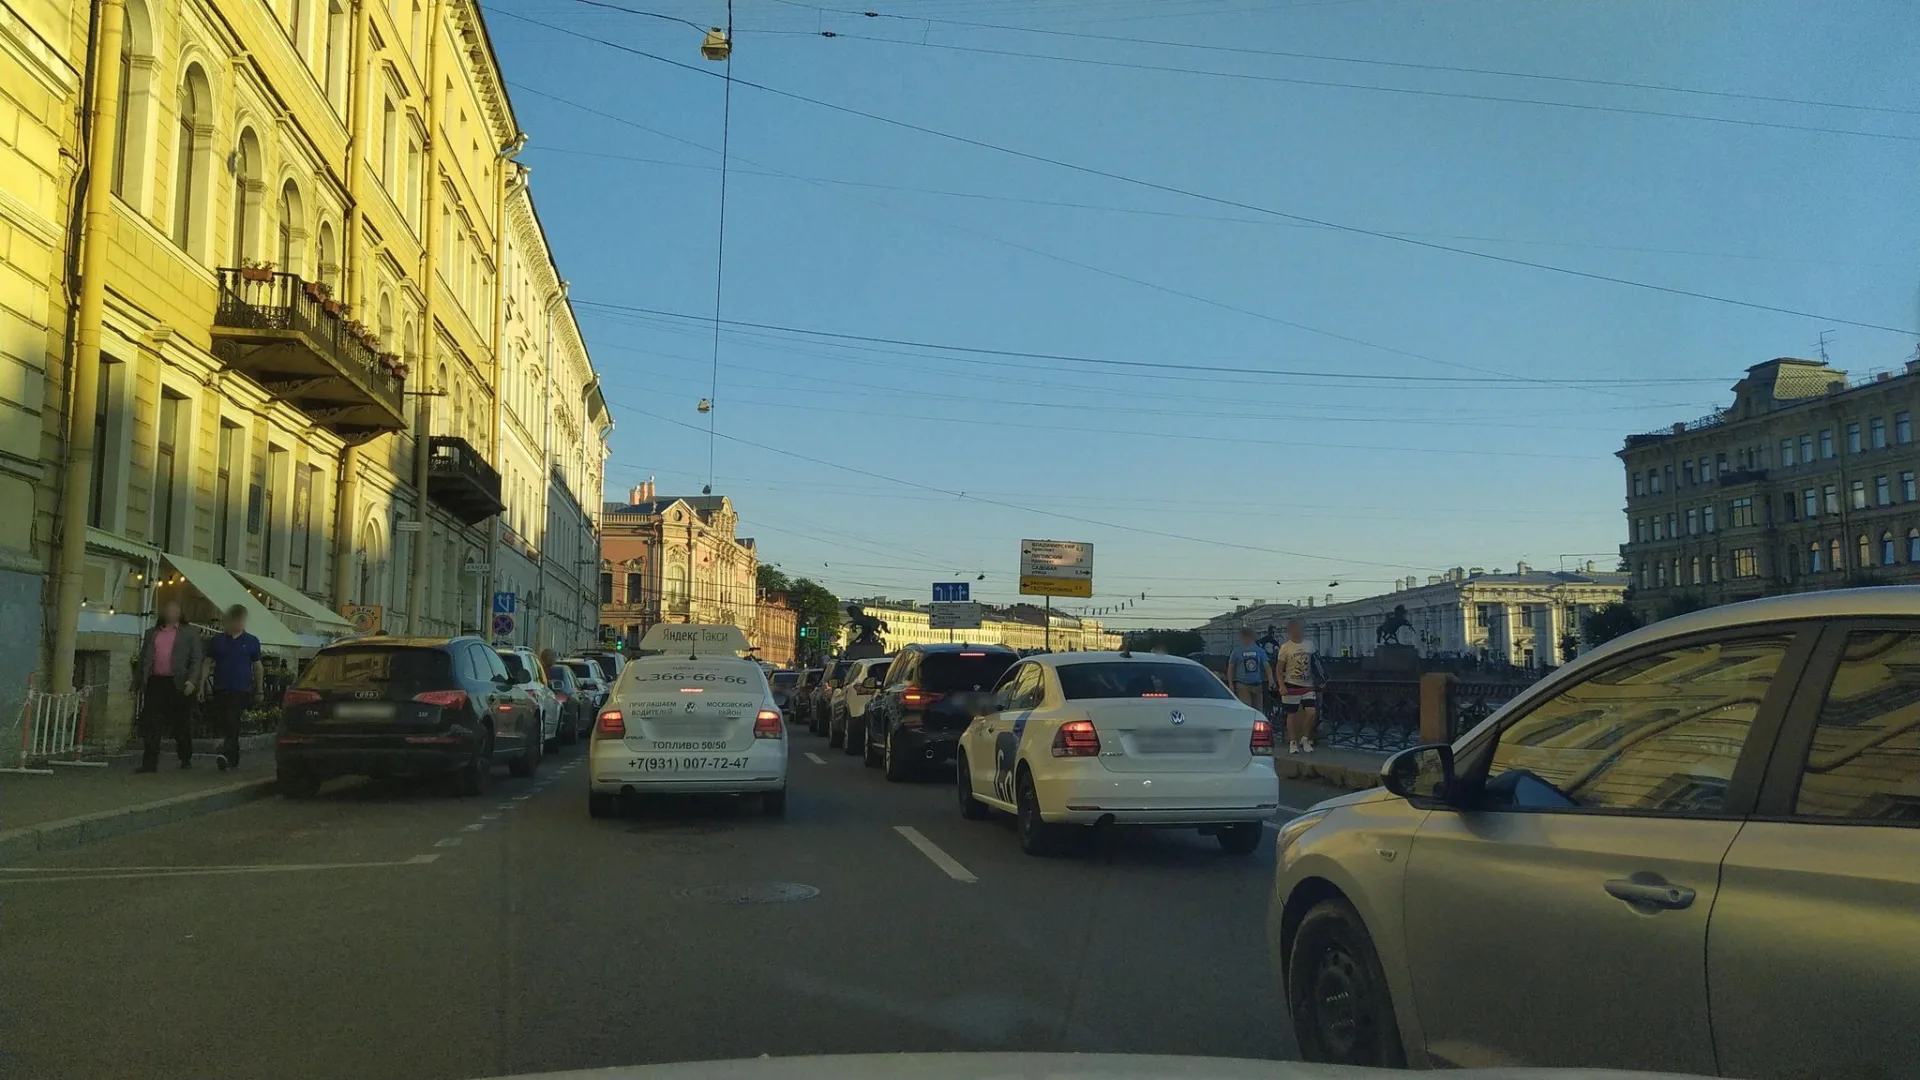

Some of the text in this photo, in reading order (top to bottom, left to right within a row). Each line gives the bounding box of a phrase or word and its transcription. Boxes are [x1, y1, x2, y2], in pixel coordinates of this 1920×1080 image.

[663, 628, 728, 643] Яндекс Такси
[648, 673, 747, 685] 366-66-66
[629, 701, 677, 709] ПРИГЛАШАЕМ
[706, 701, 753, 709] МОСКОВСКИЙ
[631, 708, 673, 716] ВОДИТЕЛЕЙ
[718, 708, 742, 716] РАЙОН
[652, 741, 727, 750] ТОПЛИВО 50/50
[628, 757, 749, 772] +7(931) 007-72-47
